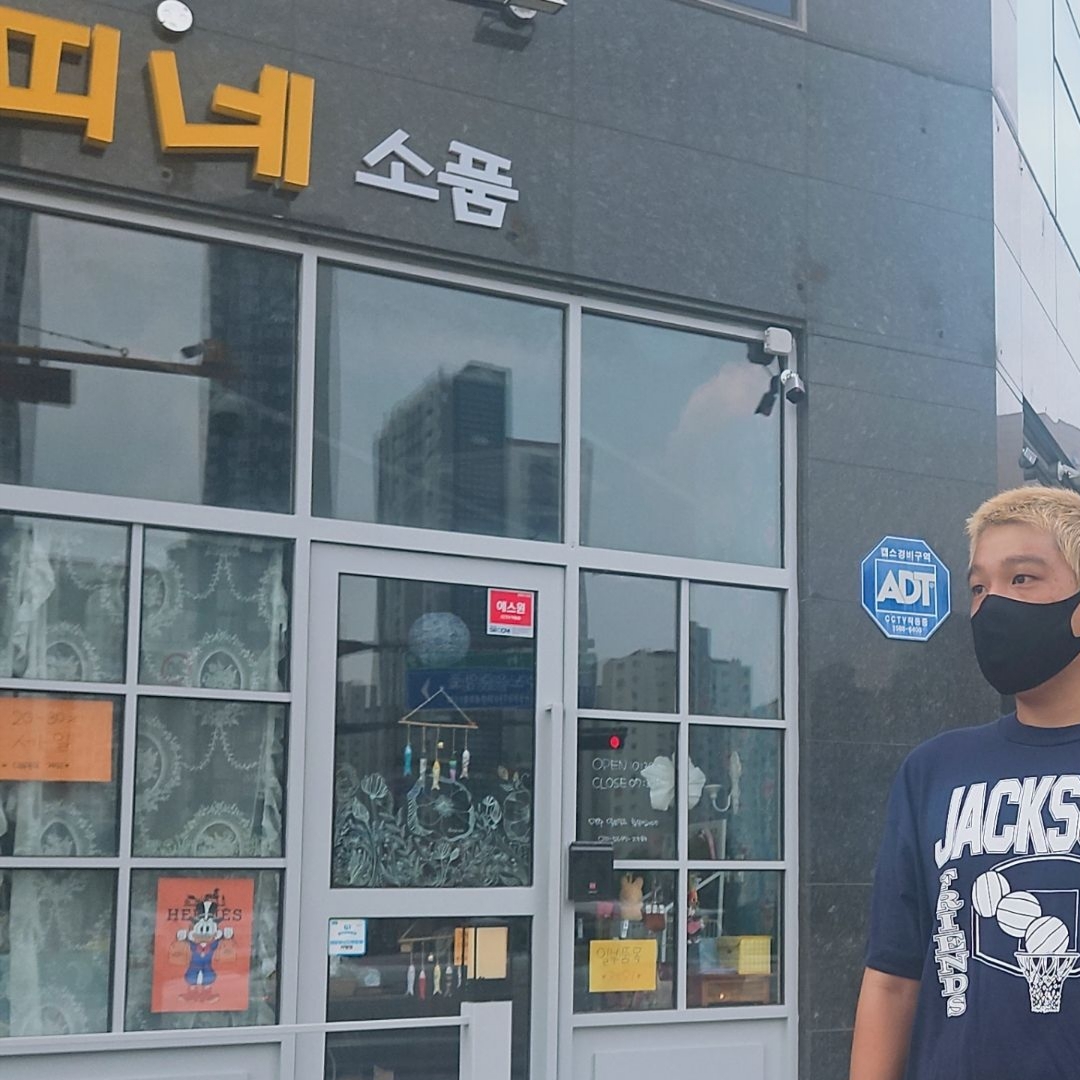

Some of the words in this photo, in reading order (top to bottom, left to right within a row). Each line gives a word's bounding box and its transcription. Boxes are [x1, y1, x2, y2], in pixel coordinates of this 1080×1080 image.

[355, 129, 519, 228] 소품
[877, 569, 936, 607] ADT
[496, 600, 526, 615] 에스원
[592, 757, 627, 772] OPEN
[592, 776, 627, 790] CLOSE
[167, 908, 243, 922] HEES
[933, 868, 970, 1018] FRIENDS
